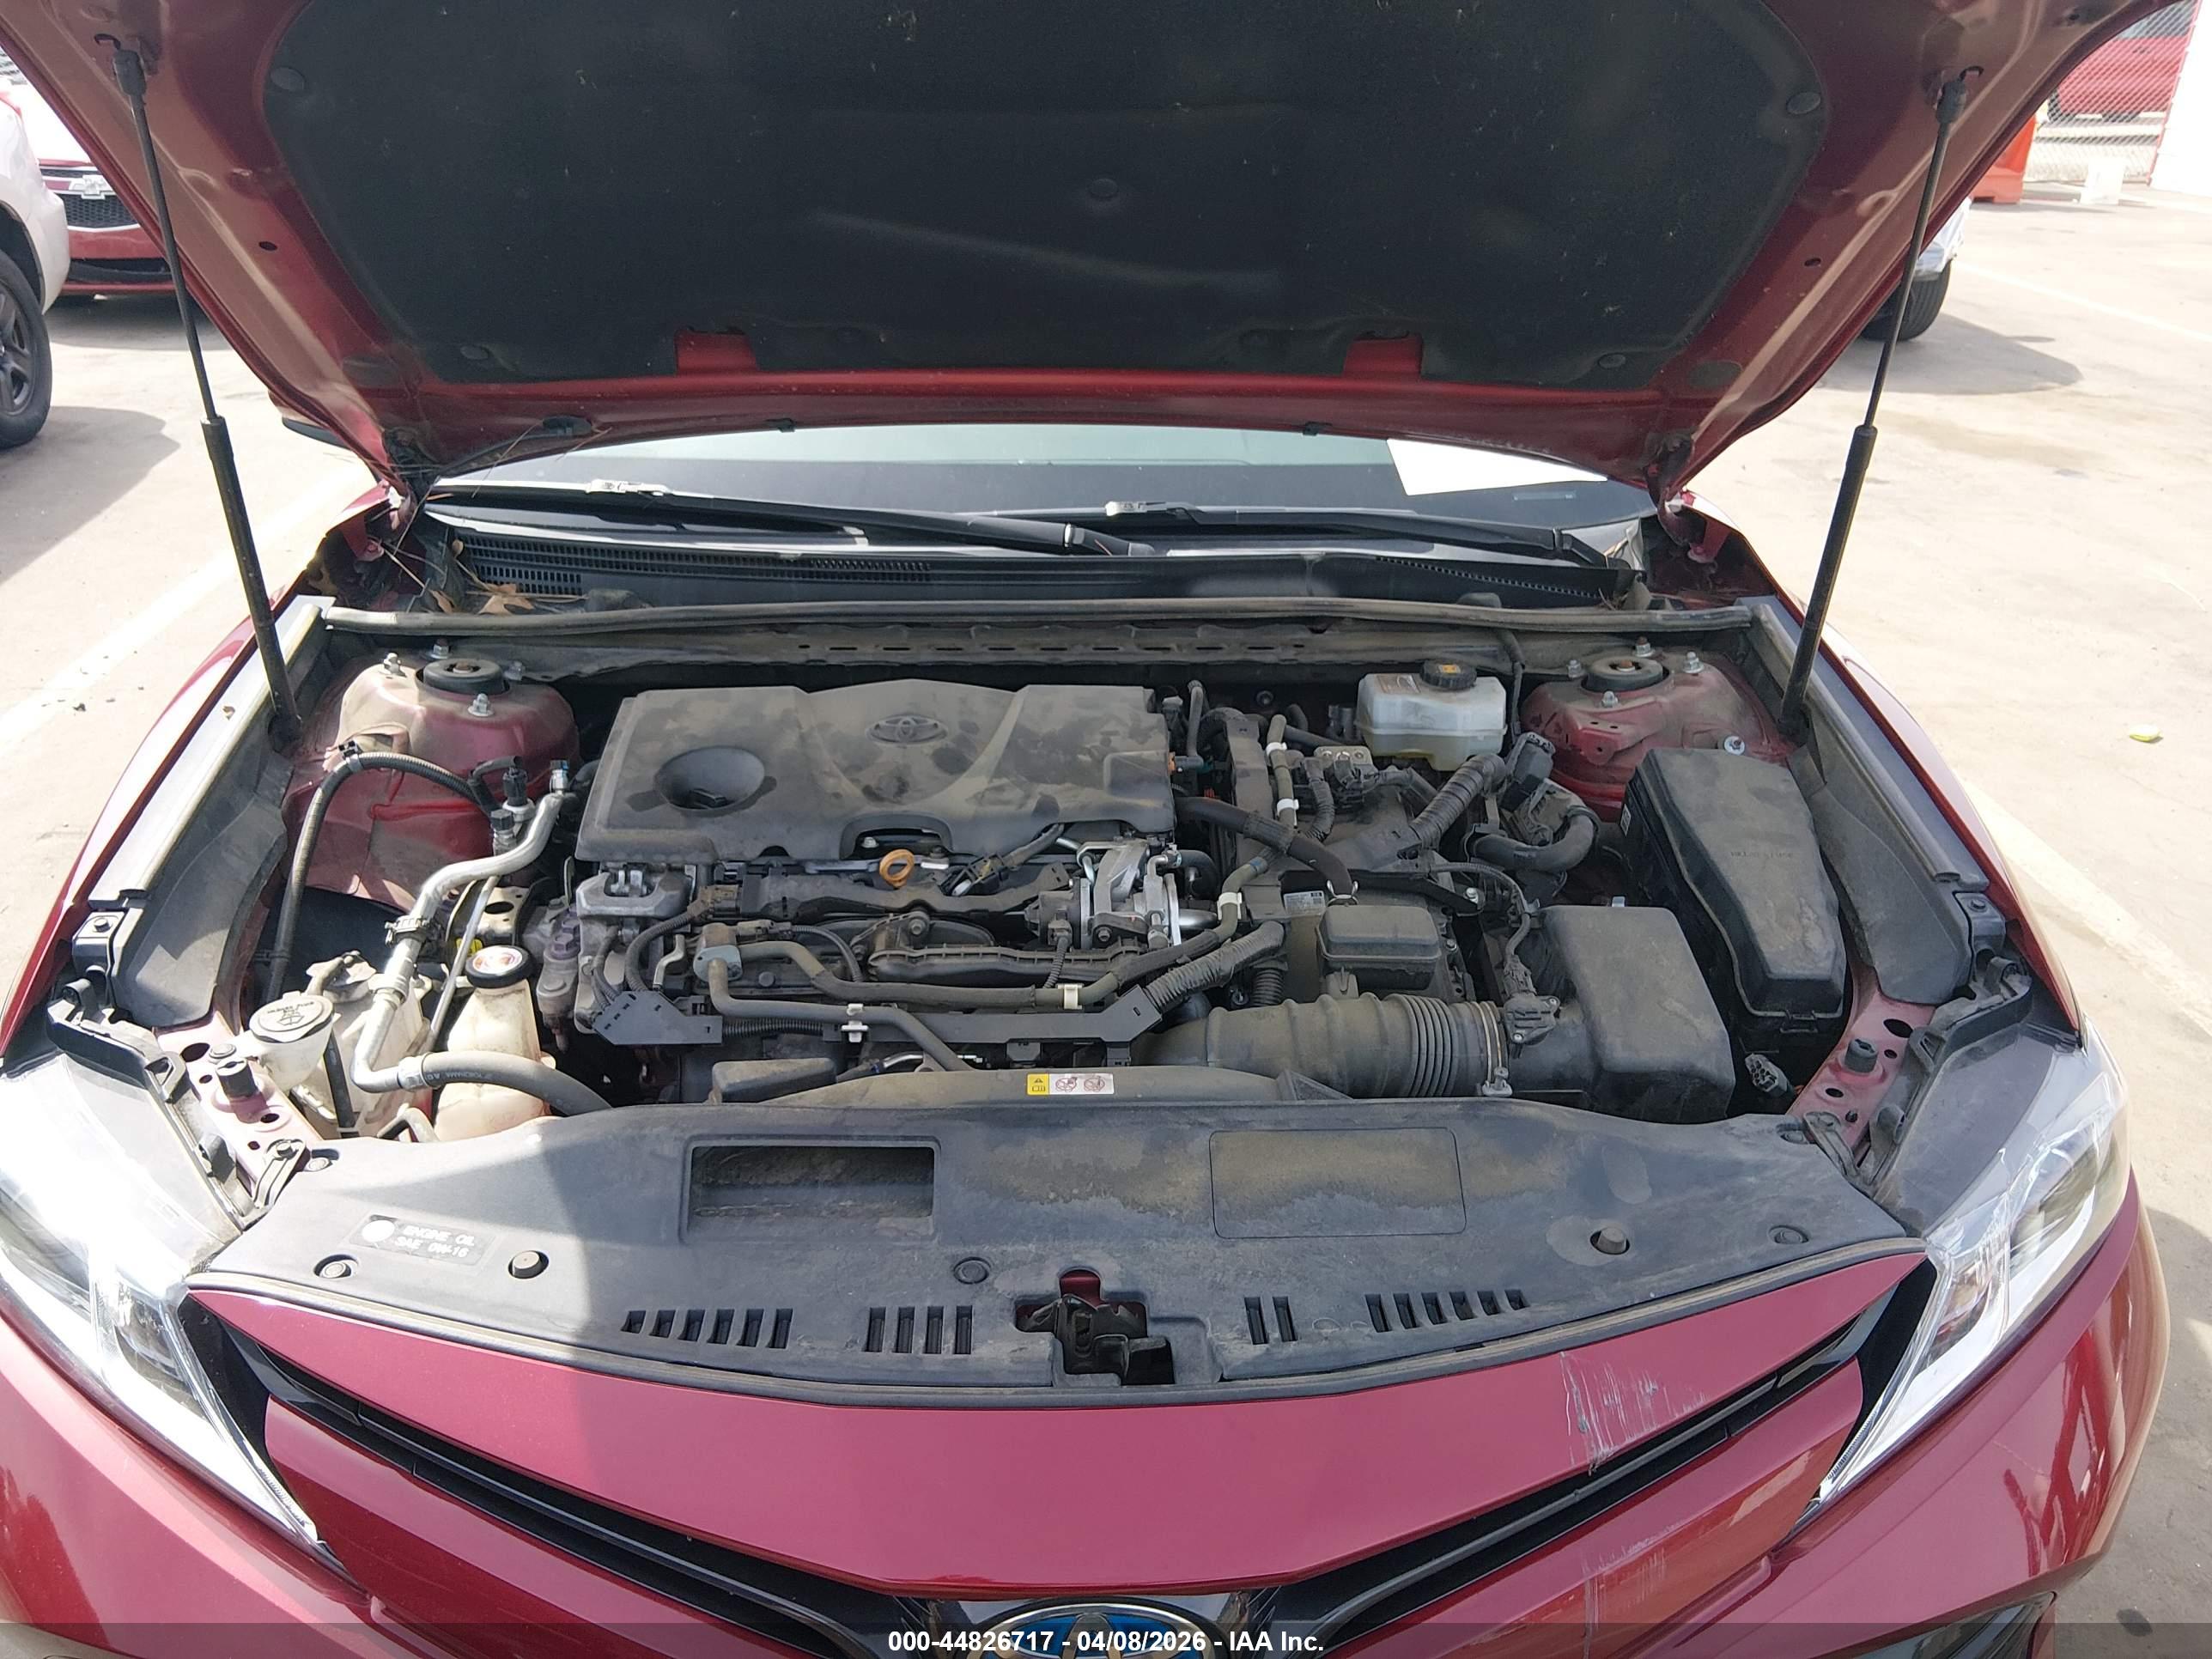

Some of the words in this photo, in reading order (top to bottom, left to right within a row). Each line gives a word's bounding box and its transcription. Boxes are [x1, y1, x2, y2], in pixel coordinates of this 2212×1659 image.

[403, 1225, 451, 1243] ENGINE
[455, 1234, 475, 1247] OIL
[395, 1237, 422, 1249] SAE
[428, 1242, 469, 1258] 0W-16
